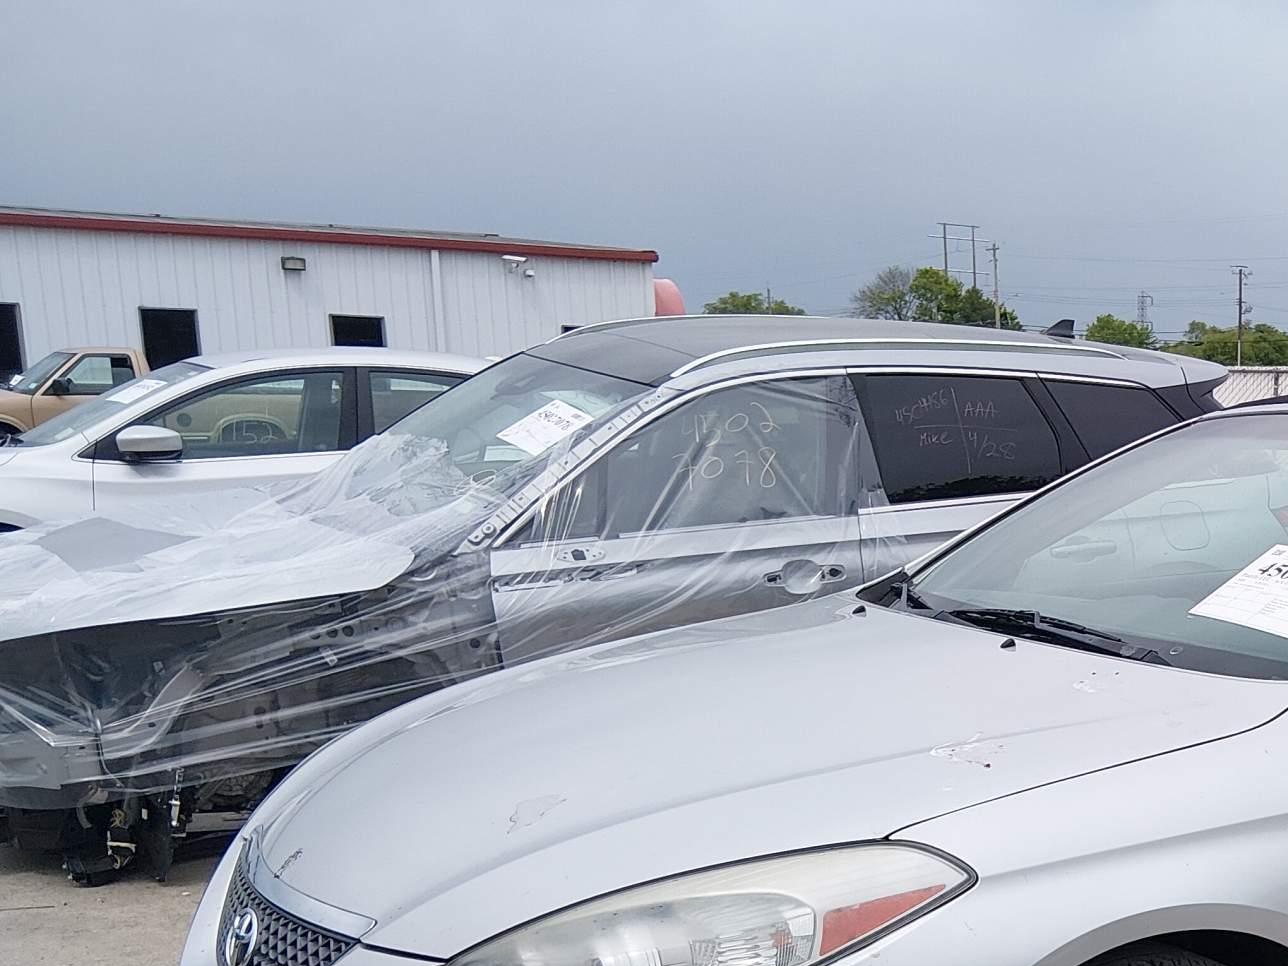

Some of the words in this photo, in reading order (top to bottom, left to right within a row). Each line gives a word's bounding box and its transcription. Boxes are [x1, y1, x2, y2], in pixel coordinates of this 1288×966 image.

[681, 401, 782, 448] 4502
[963, 401, 1001, 417] AAA
[671, 446, 777, 491] 7078
